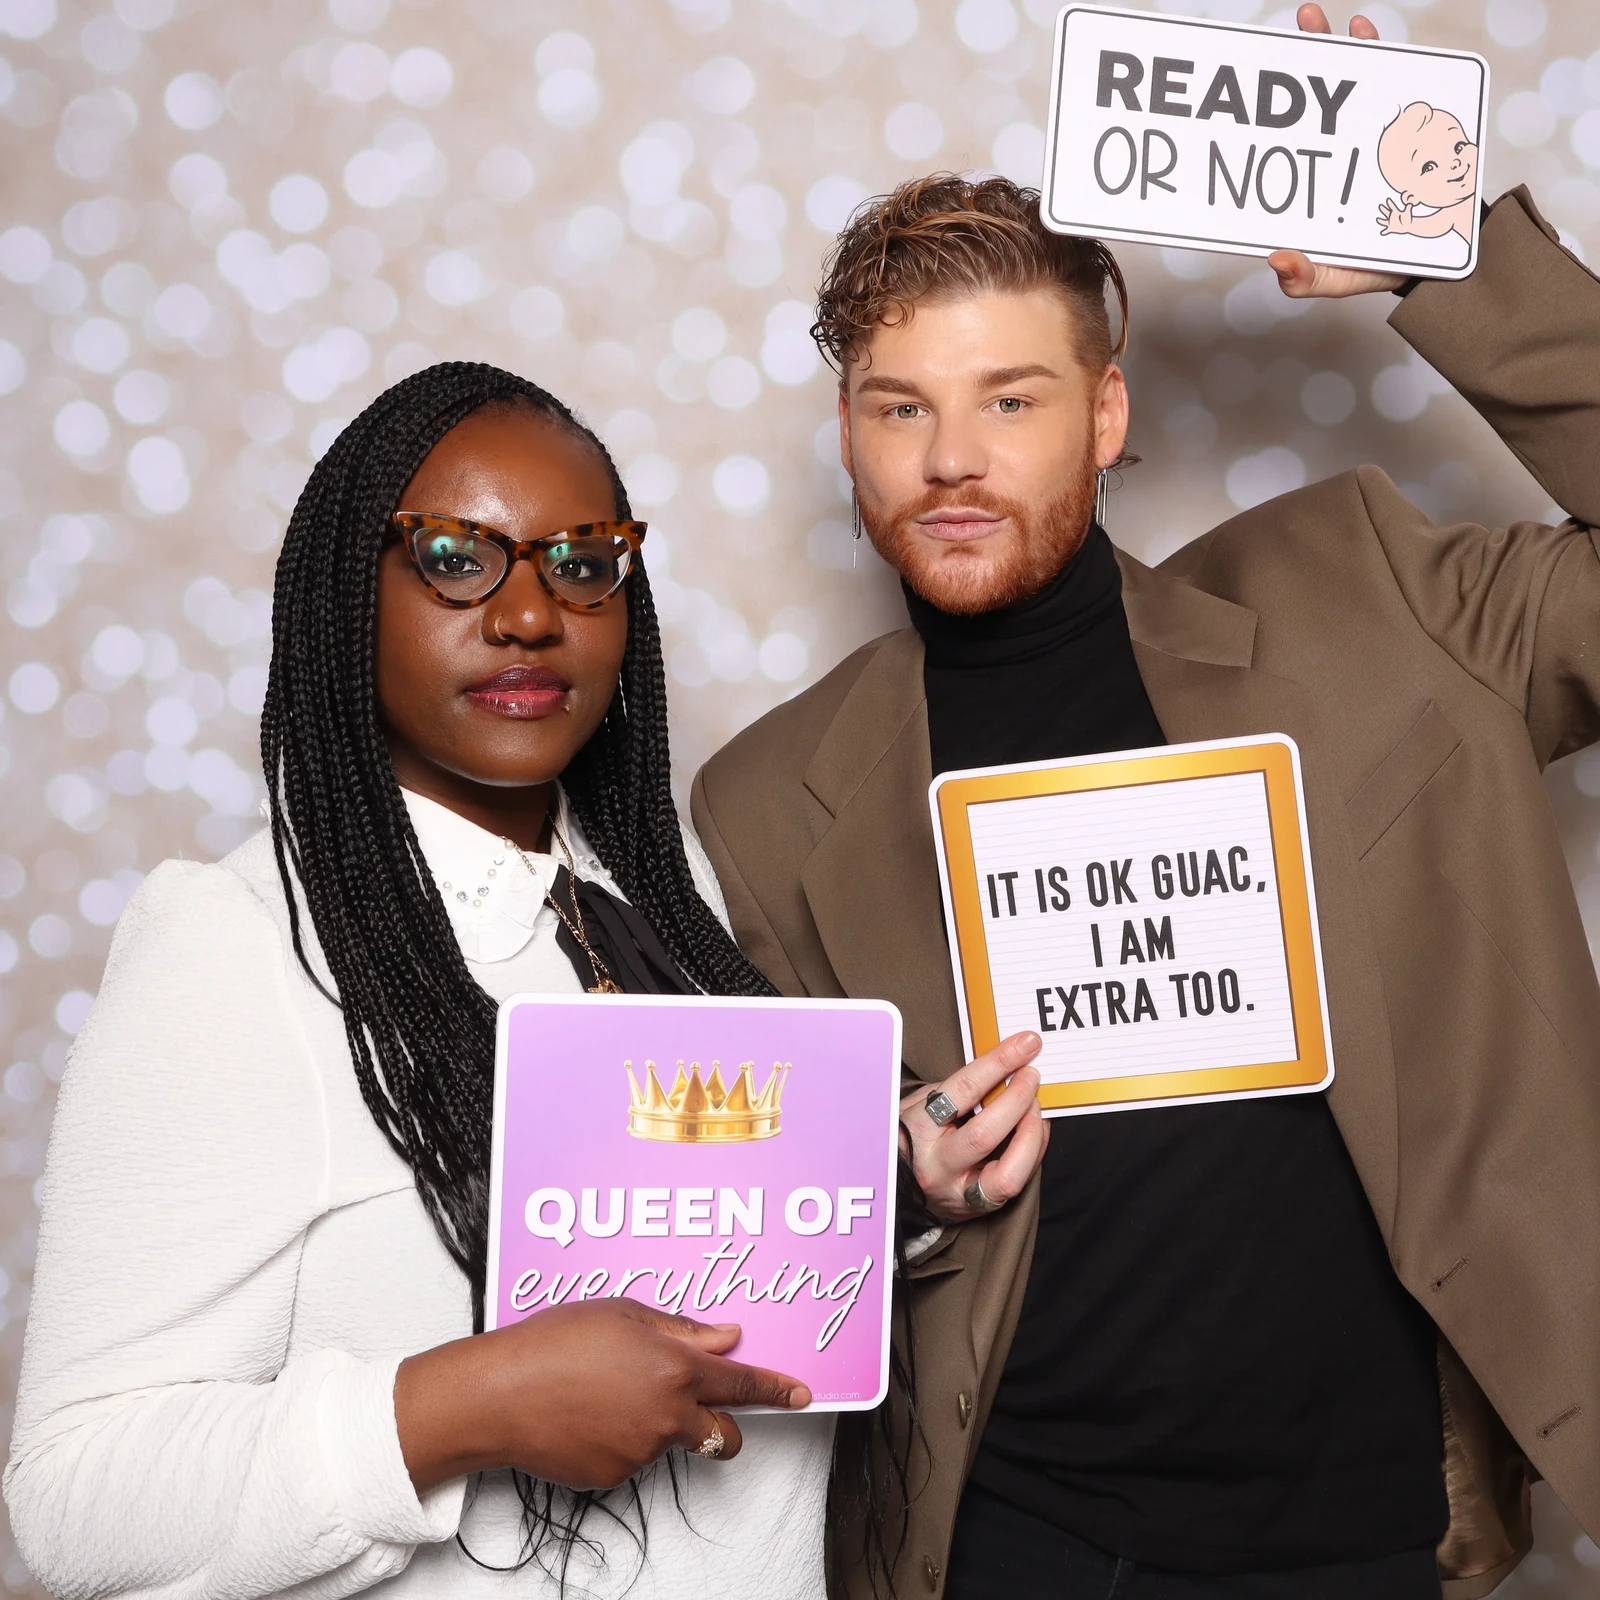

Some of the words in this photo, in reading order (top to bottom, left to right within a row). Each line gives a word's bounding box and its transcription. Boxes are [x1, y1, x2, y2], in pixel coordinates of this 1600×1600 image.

[1096, 49, 1358, 136] READY
[1093, 125, 1178, 201] OR
[1207, 140, 1360, 224] NOT!
[986, 870, 1019, 919] IT
[1034, 865, 1072, 914] IS
[1085, 857, 1139, 908] OK
[1151, 845, 1267, 901] GUAC,
[1090, 922, 1104, 968] I
[1119, 914, 1176, 966] AM
[1035, 977, 1159, 1033] EXTRA
[1168, 967, 1256, 1019] TOO.
[523, 1186, 765, 1249] QUEEN
[784, 1185, 875, 1236] OF
[510, 1239, 874, 1352] everything
[811, 1391, 861, 1401] studio.com
